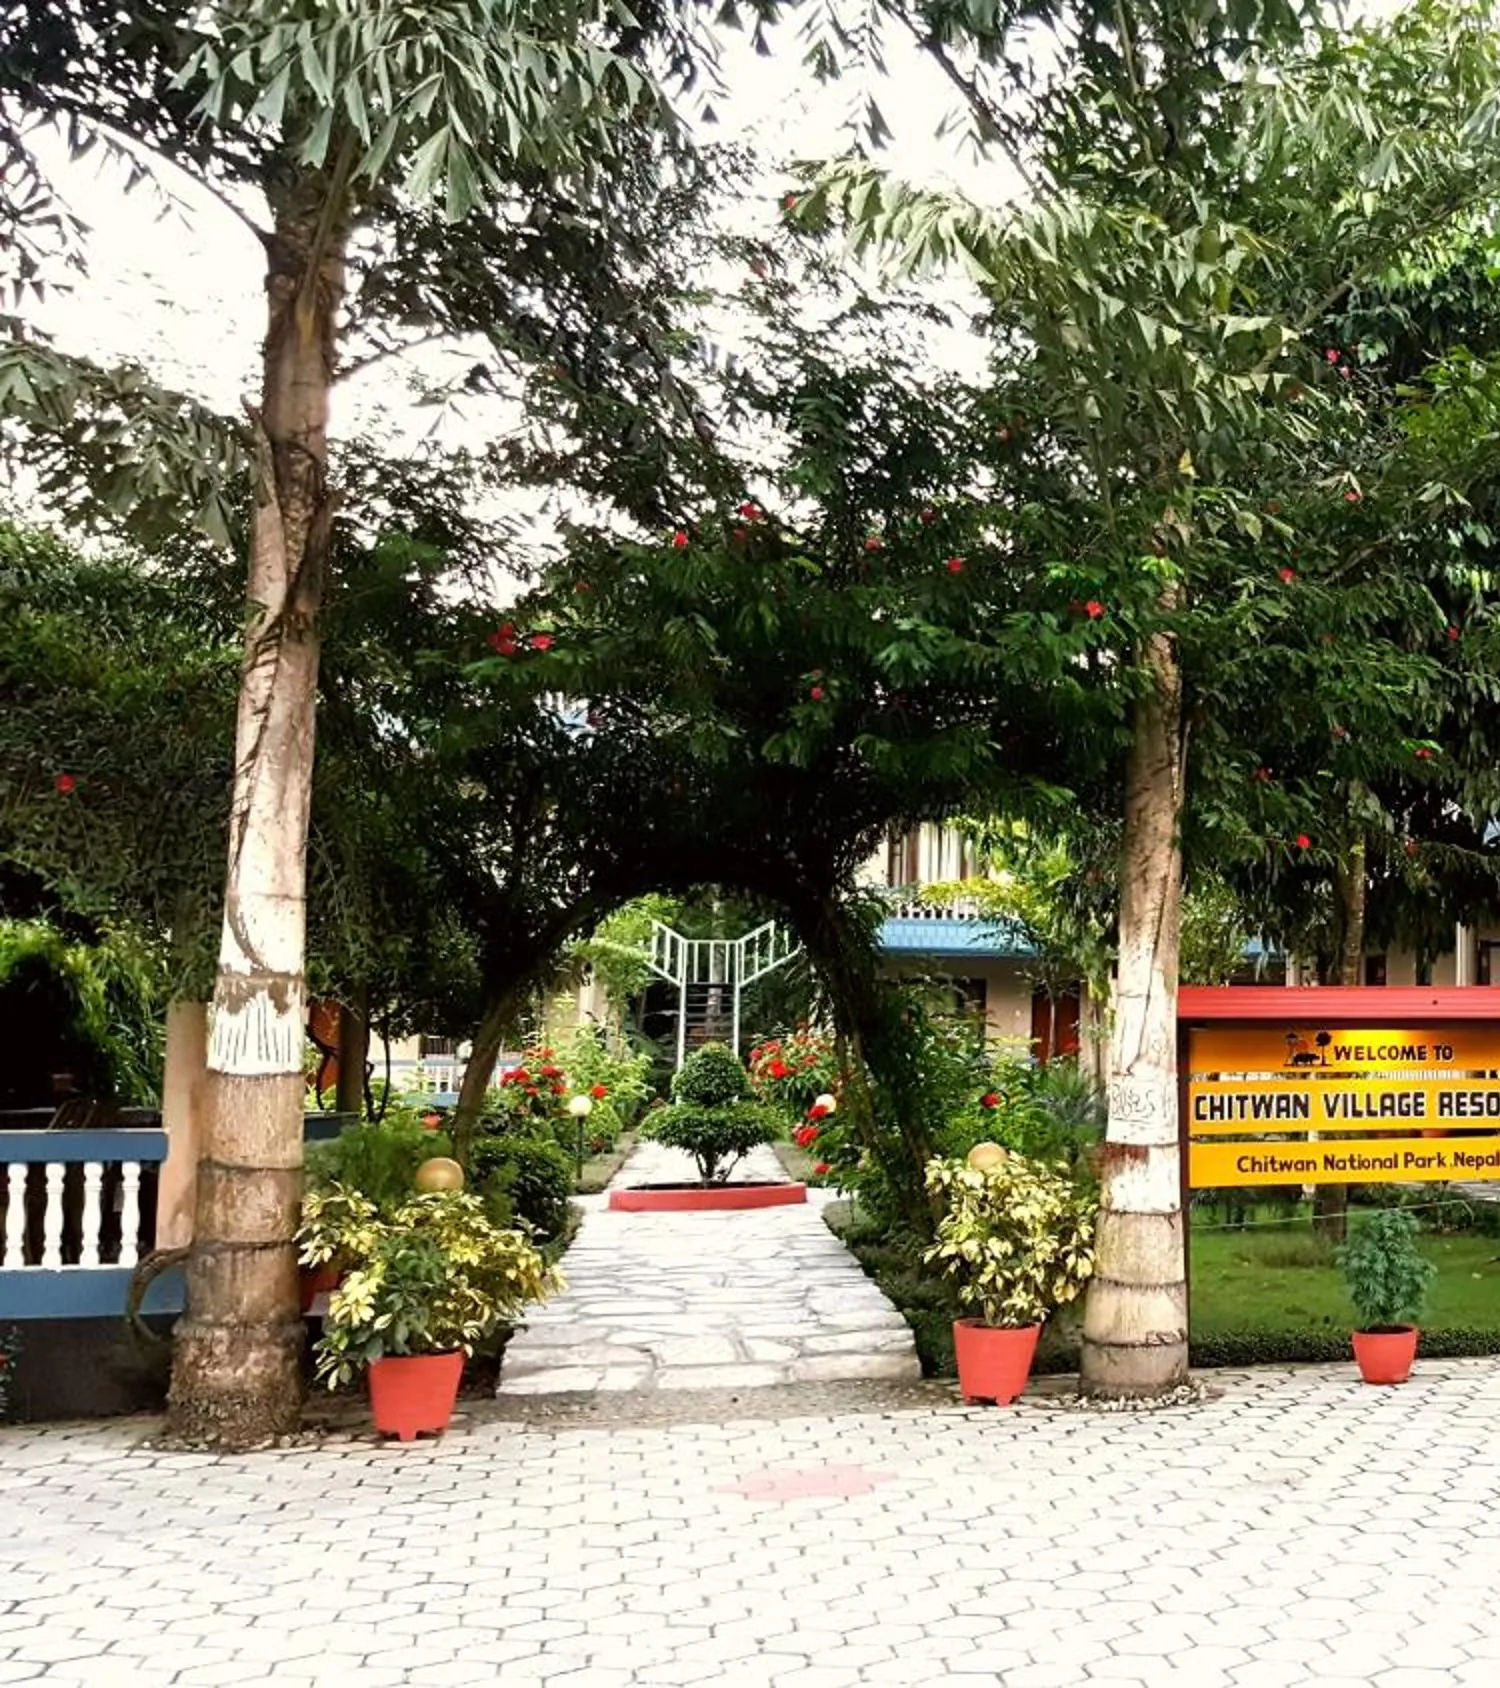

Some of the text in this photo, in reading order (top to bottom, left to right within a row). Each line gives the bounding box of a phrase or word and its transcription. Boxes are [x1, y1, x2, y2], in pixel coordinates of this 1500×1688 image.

[1333, 1044, 1453, 1061] WELCOME TO
[1195, 1094, 1309, 1120] CHITWAN
[1323, 1092, 1425, 1118] VILLAGE
[1237, 1155, 1317, 1172] Chitwan
[1323, 1152, 1398, 1170] National
